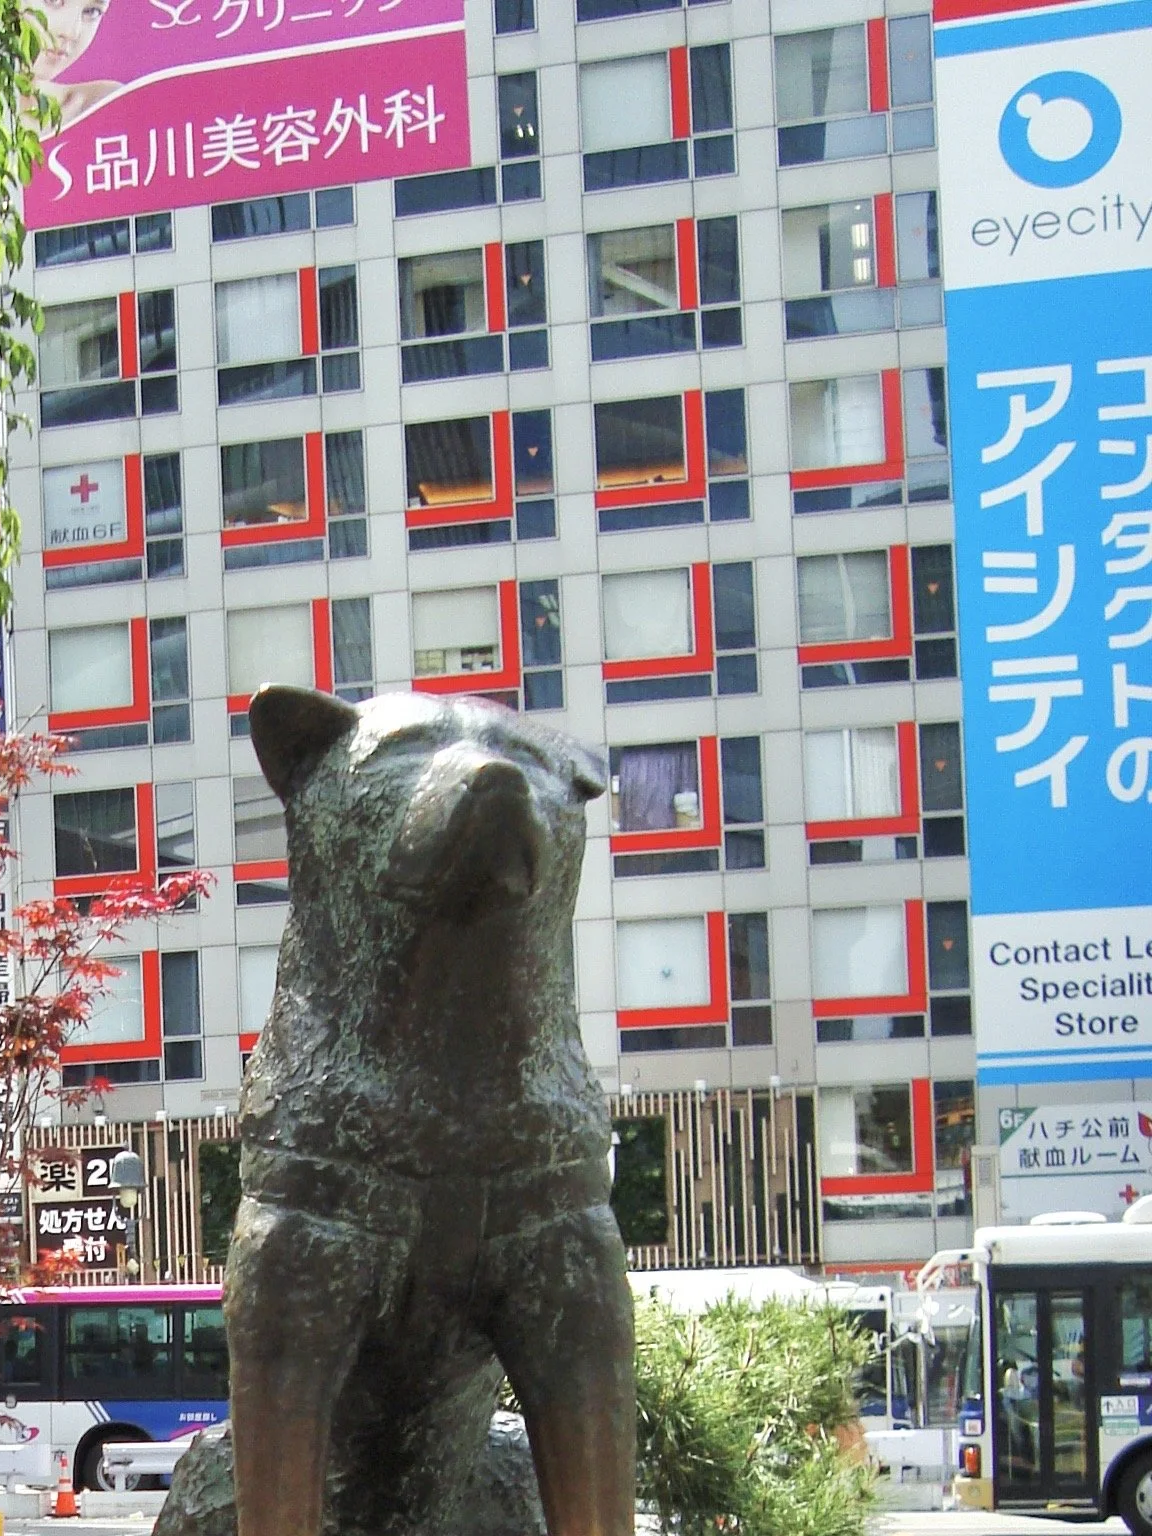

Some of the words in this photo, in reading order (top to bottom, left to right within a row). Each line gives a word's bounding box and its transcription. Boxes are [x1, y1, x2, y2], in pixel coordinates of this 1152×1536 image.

[85, 85, 446, 195] 品川美容外科
[976, 363, 1090, 809] アイシティ
[989, 936, 1112, 967] Contact
[1055, 1011, 1139, 1036] Store
[999, 1109, 1026, 1130] 6F
[1028, 1116, 1130, 1139] ハチ公前
[1018, 1144, 1141, 1169] 献血ルーム
[39, 1206, 126, 1235] 処方せん
